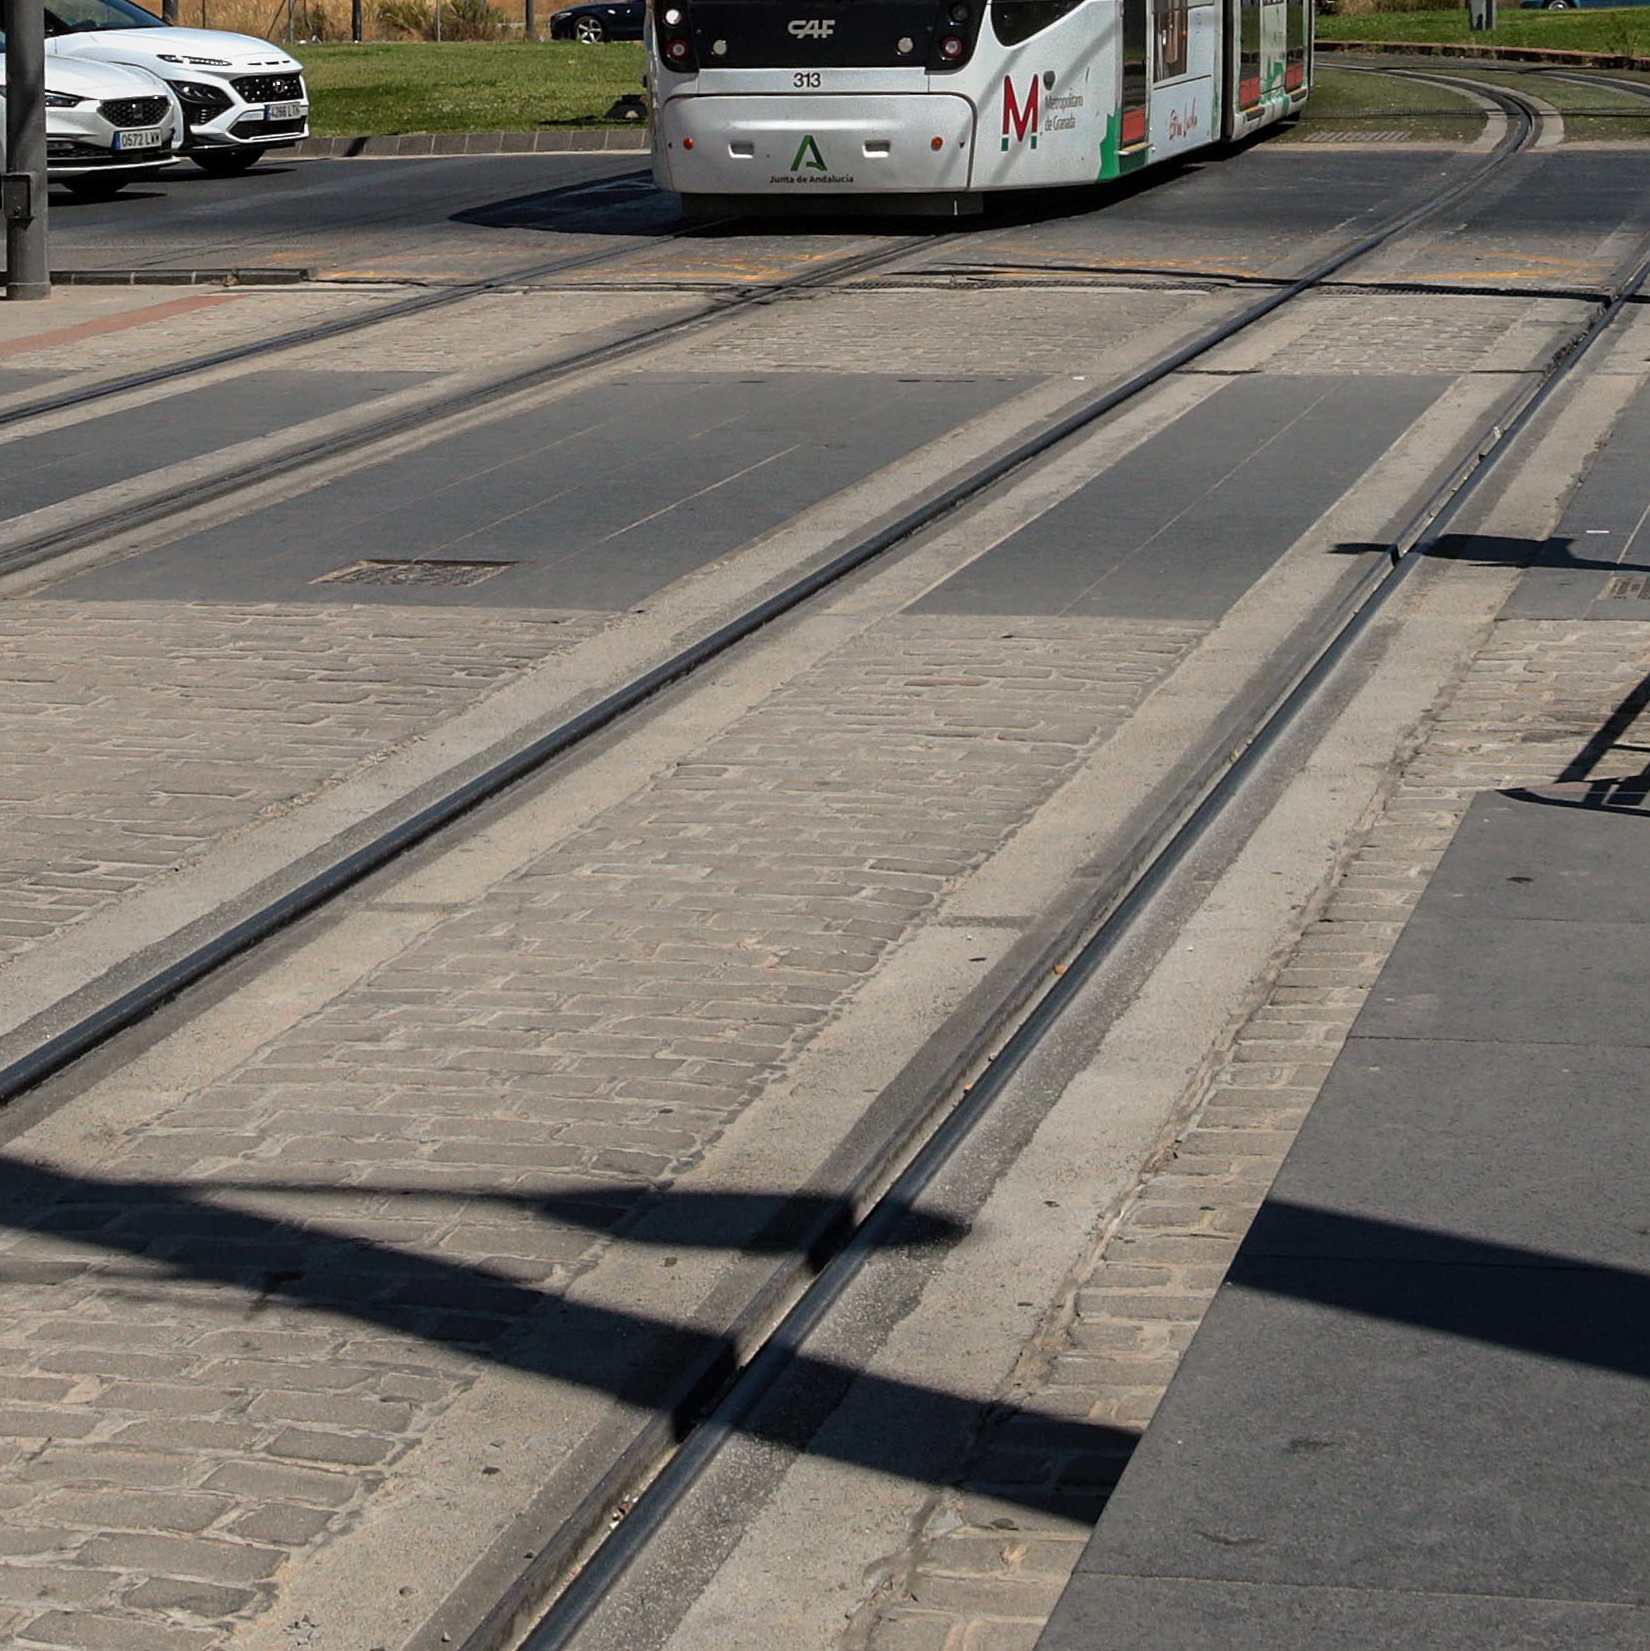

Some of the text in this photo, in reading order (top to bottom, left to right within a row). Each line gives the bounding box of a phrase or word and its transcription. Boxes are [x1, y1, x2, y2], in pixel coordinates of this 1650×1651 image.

[787, 19, 836, 39] CAF
[793, 72, 821, 88] 313
[769, 175, 795, 184] Junta
[797, 175, 807, 183] de
